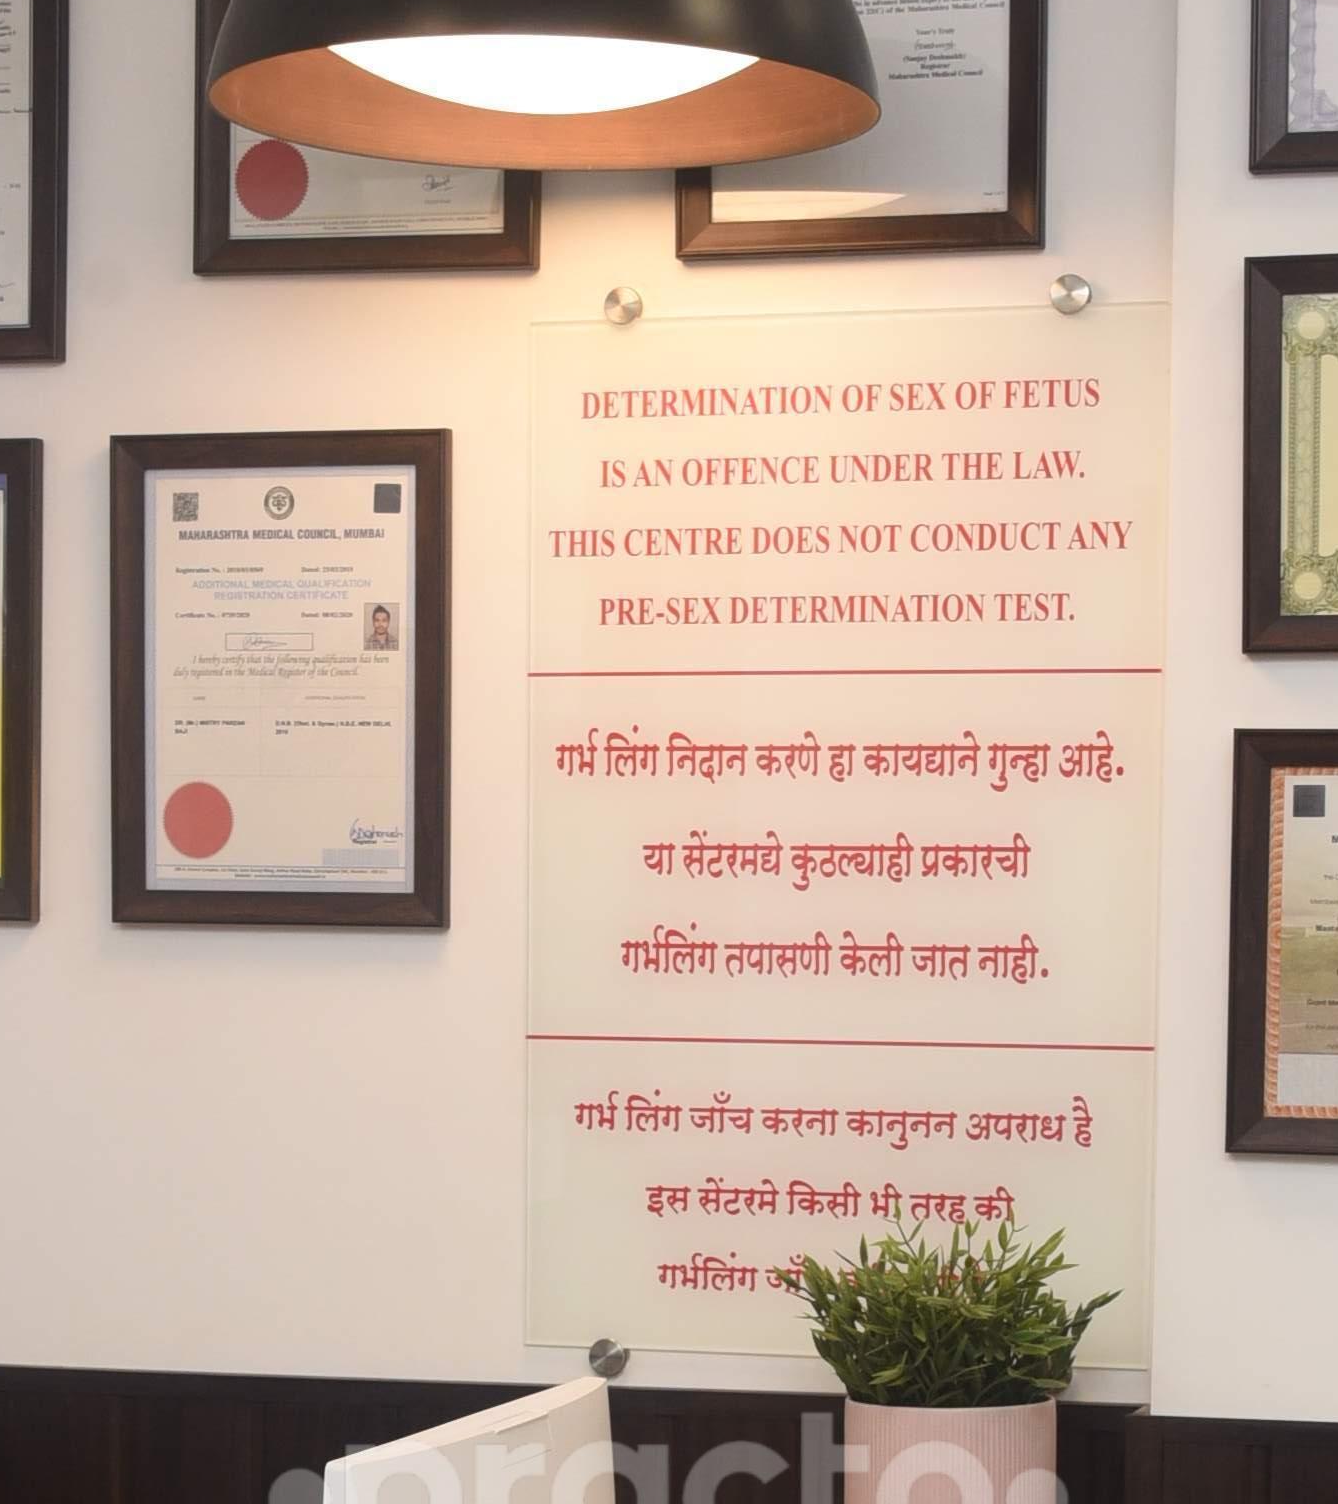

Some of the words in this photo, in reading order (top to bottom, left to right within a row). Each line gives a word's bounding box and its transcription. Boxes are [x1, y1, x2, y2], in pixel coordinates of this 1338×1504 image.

[580, 385, 832, 419] DETERMINATION
[840, 383, 882, 413] OF
[888, 381, 946, 411] SEX
[953, 380, 997, 410] OF
[1002, 377, 1100, 409] FETUS
[600, 459, 627, 488] IS
[632, 458, 673, 487] AN
[680, 455, 820, 486] OFFENCE
[829, 452, 934, 483] UNDER
[940, 451, 1004, 481] THE
[1012, 449, 1085, 480] LAW.
[177, 528, 250, 541] MAHARASHTRA
[251, 528, 295, 540] MEDICAL
[295, 527, 342, 540] COUNCIL,
[342, 527, 385, 539] MUMBAI
[547, 528, 616, 558] THIS
[622, 526, 742, 556] CENTRE
[751, 525, 830, 554] DOES
[838, 523, 902, 553] NOT
[909, 521, 1062, 552] CONDUCT
[1066, 520, 1133, 550] ANY
[598, 596, 721, 626] PRE-SEX
[728, 593, 985, 624] DETERMINATION
[992, 591, 1075, 622] TEST.
